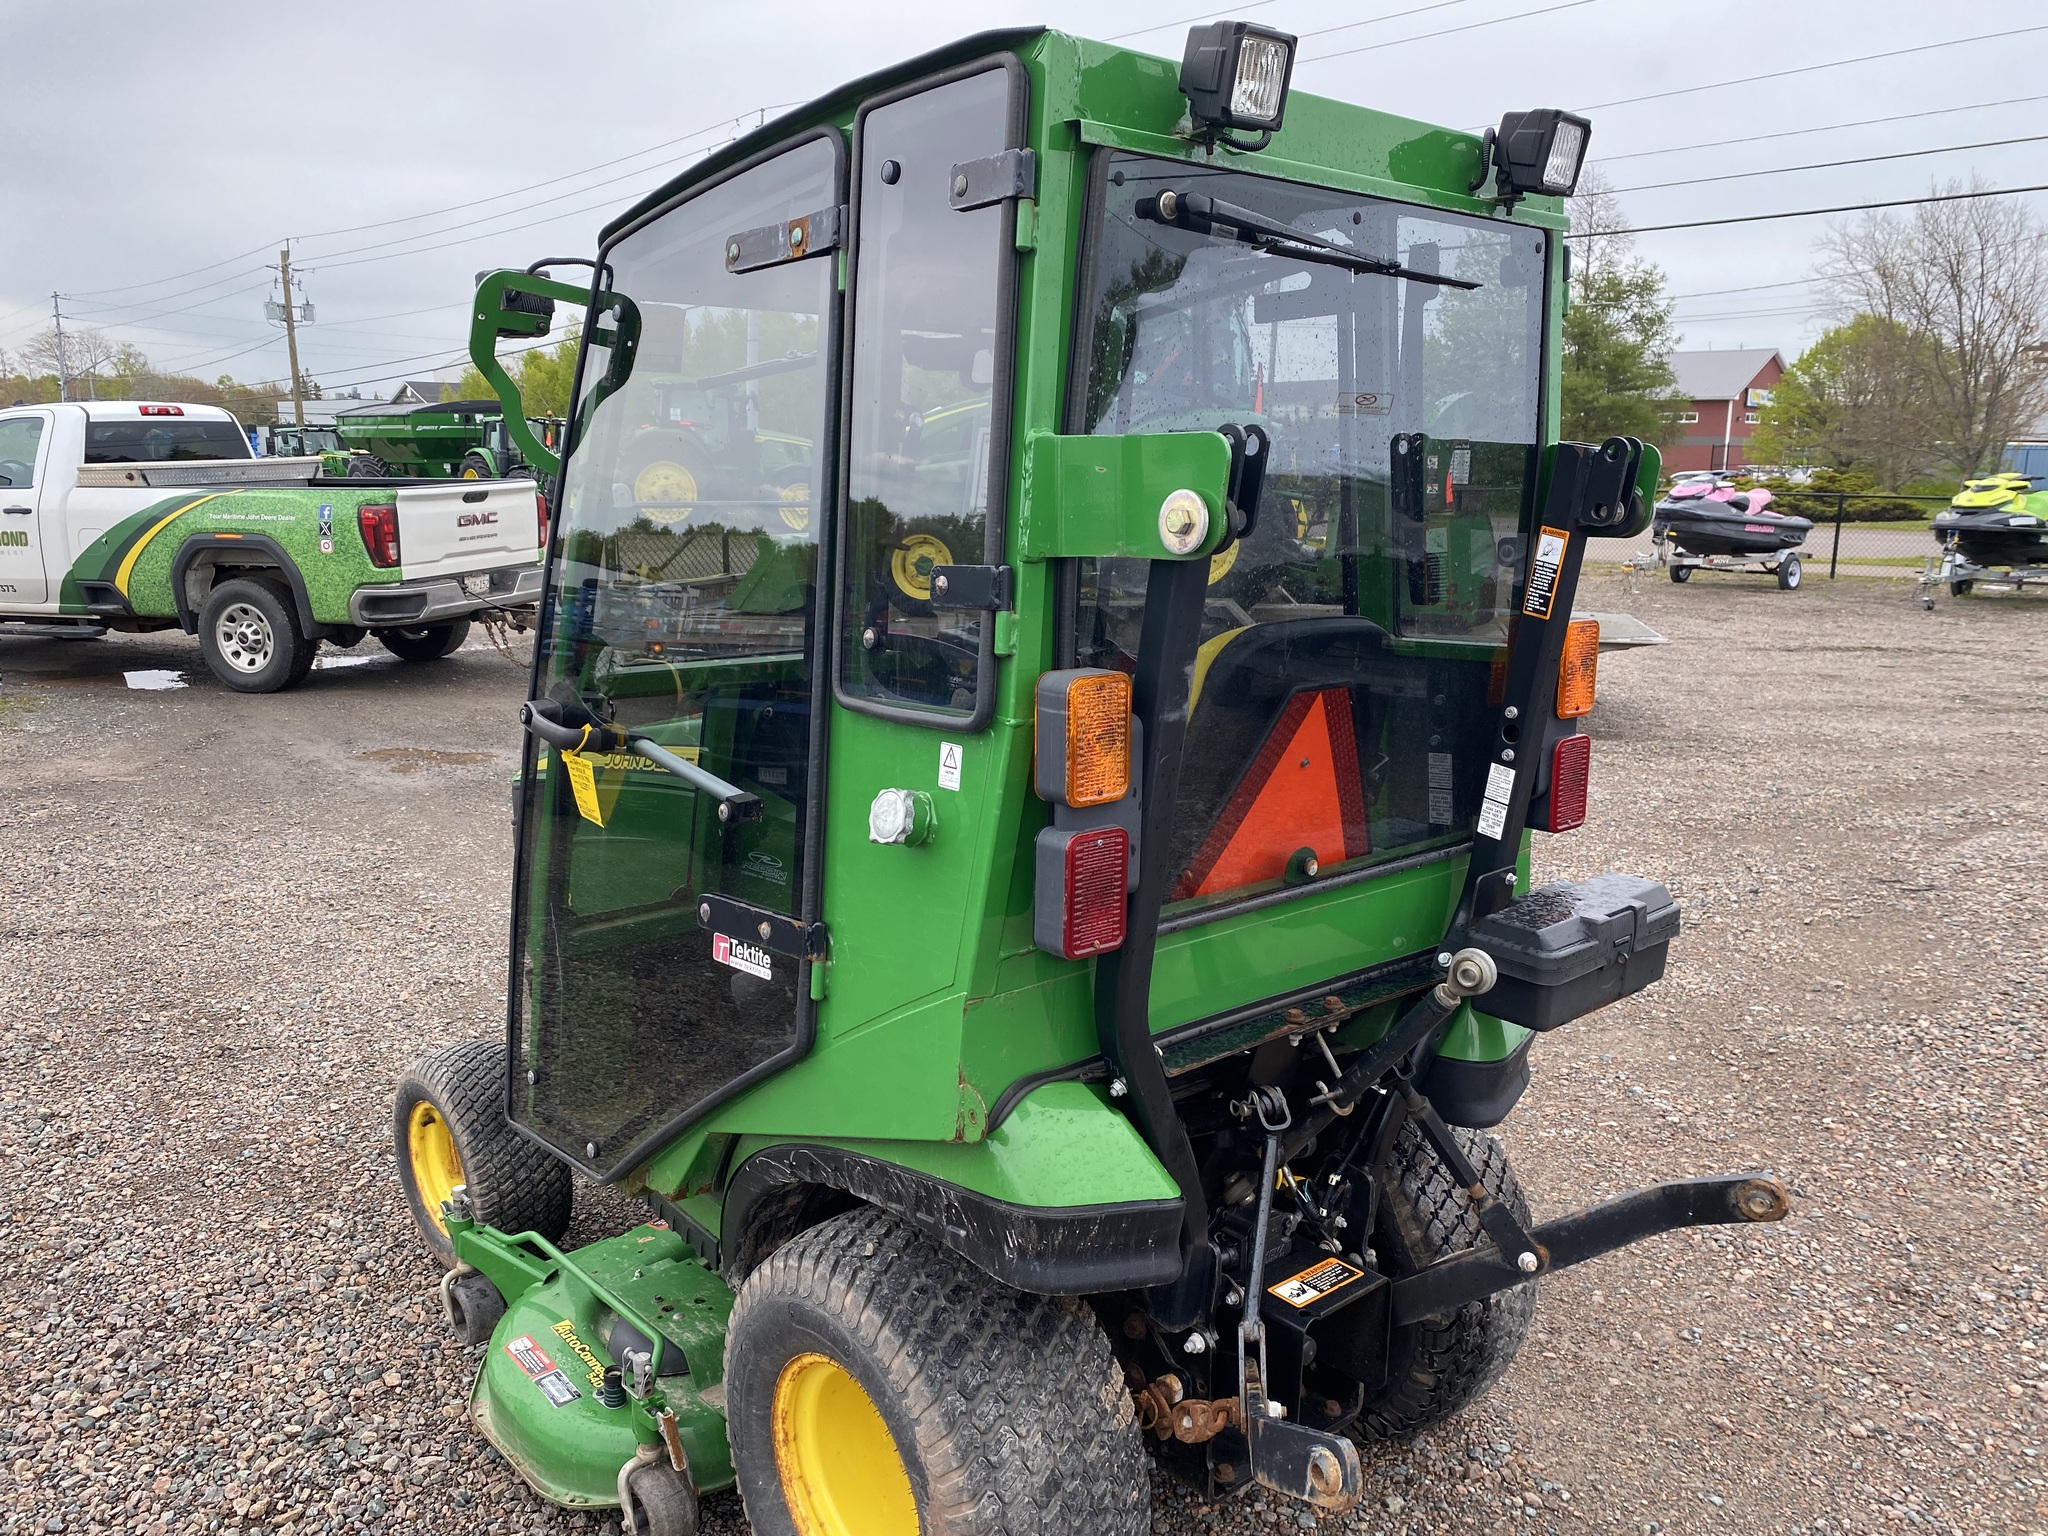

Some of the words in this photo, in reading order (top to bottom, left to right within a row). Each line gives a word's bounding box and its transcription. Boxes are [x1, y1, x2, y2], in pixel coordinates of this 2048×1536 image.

[457, 512, 498, 527] GMC
[0, 531, 28, 547] OND
[459, 533, 498, 541] SIERRA
[604, 753, 641, 769] JOHN
[730, 938, 771, 968] Tektite
